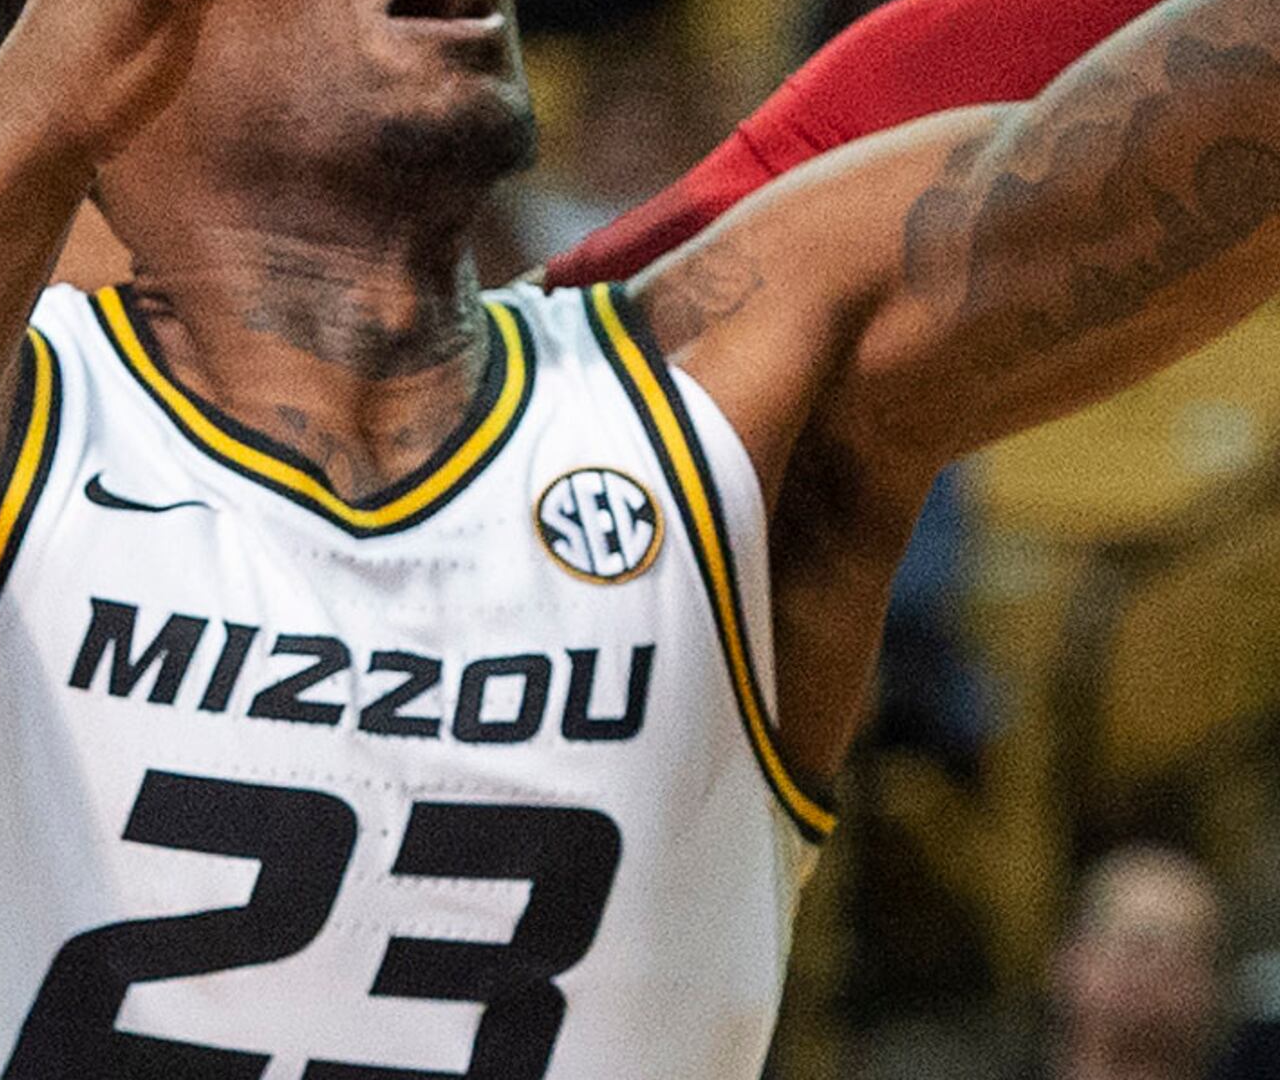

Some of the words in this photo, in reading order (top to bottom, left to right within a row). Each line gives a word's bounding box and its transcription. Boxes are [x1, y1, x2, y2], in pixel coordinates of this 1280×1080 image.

[539, 469, 658, 577] SEC
[67, 595, 656, 745] MIZZOU
[0, 768, 624, 1080] 23
